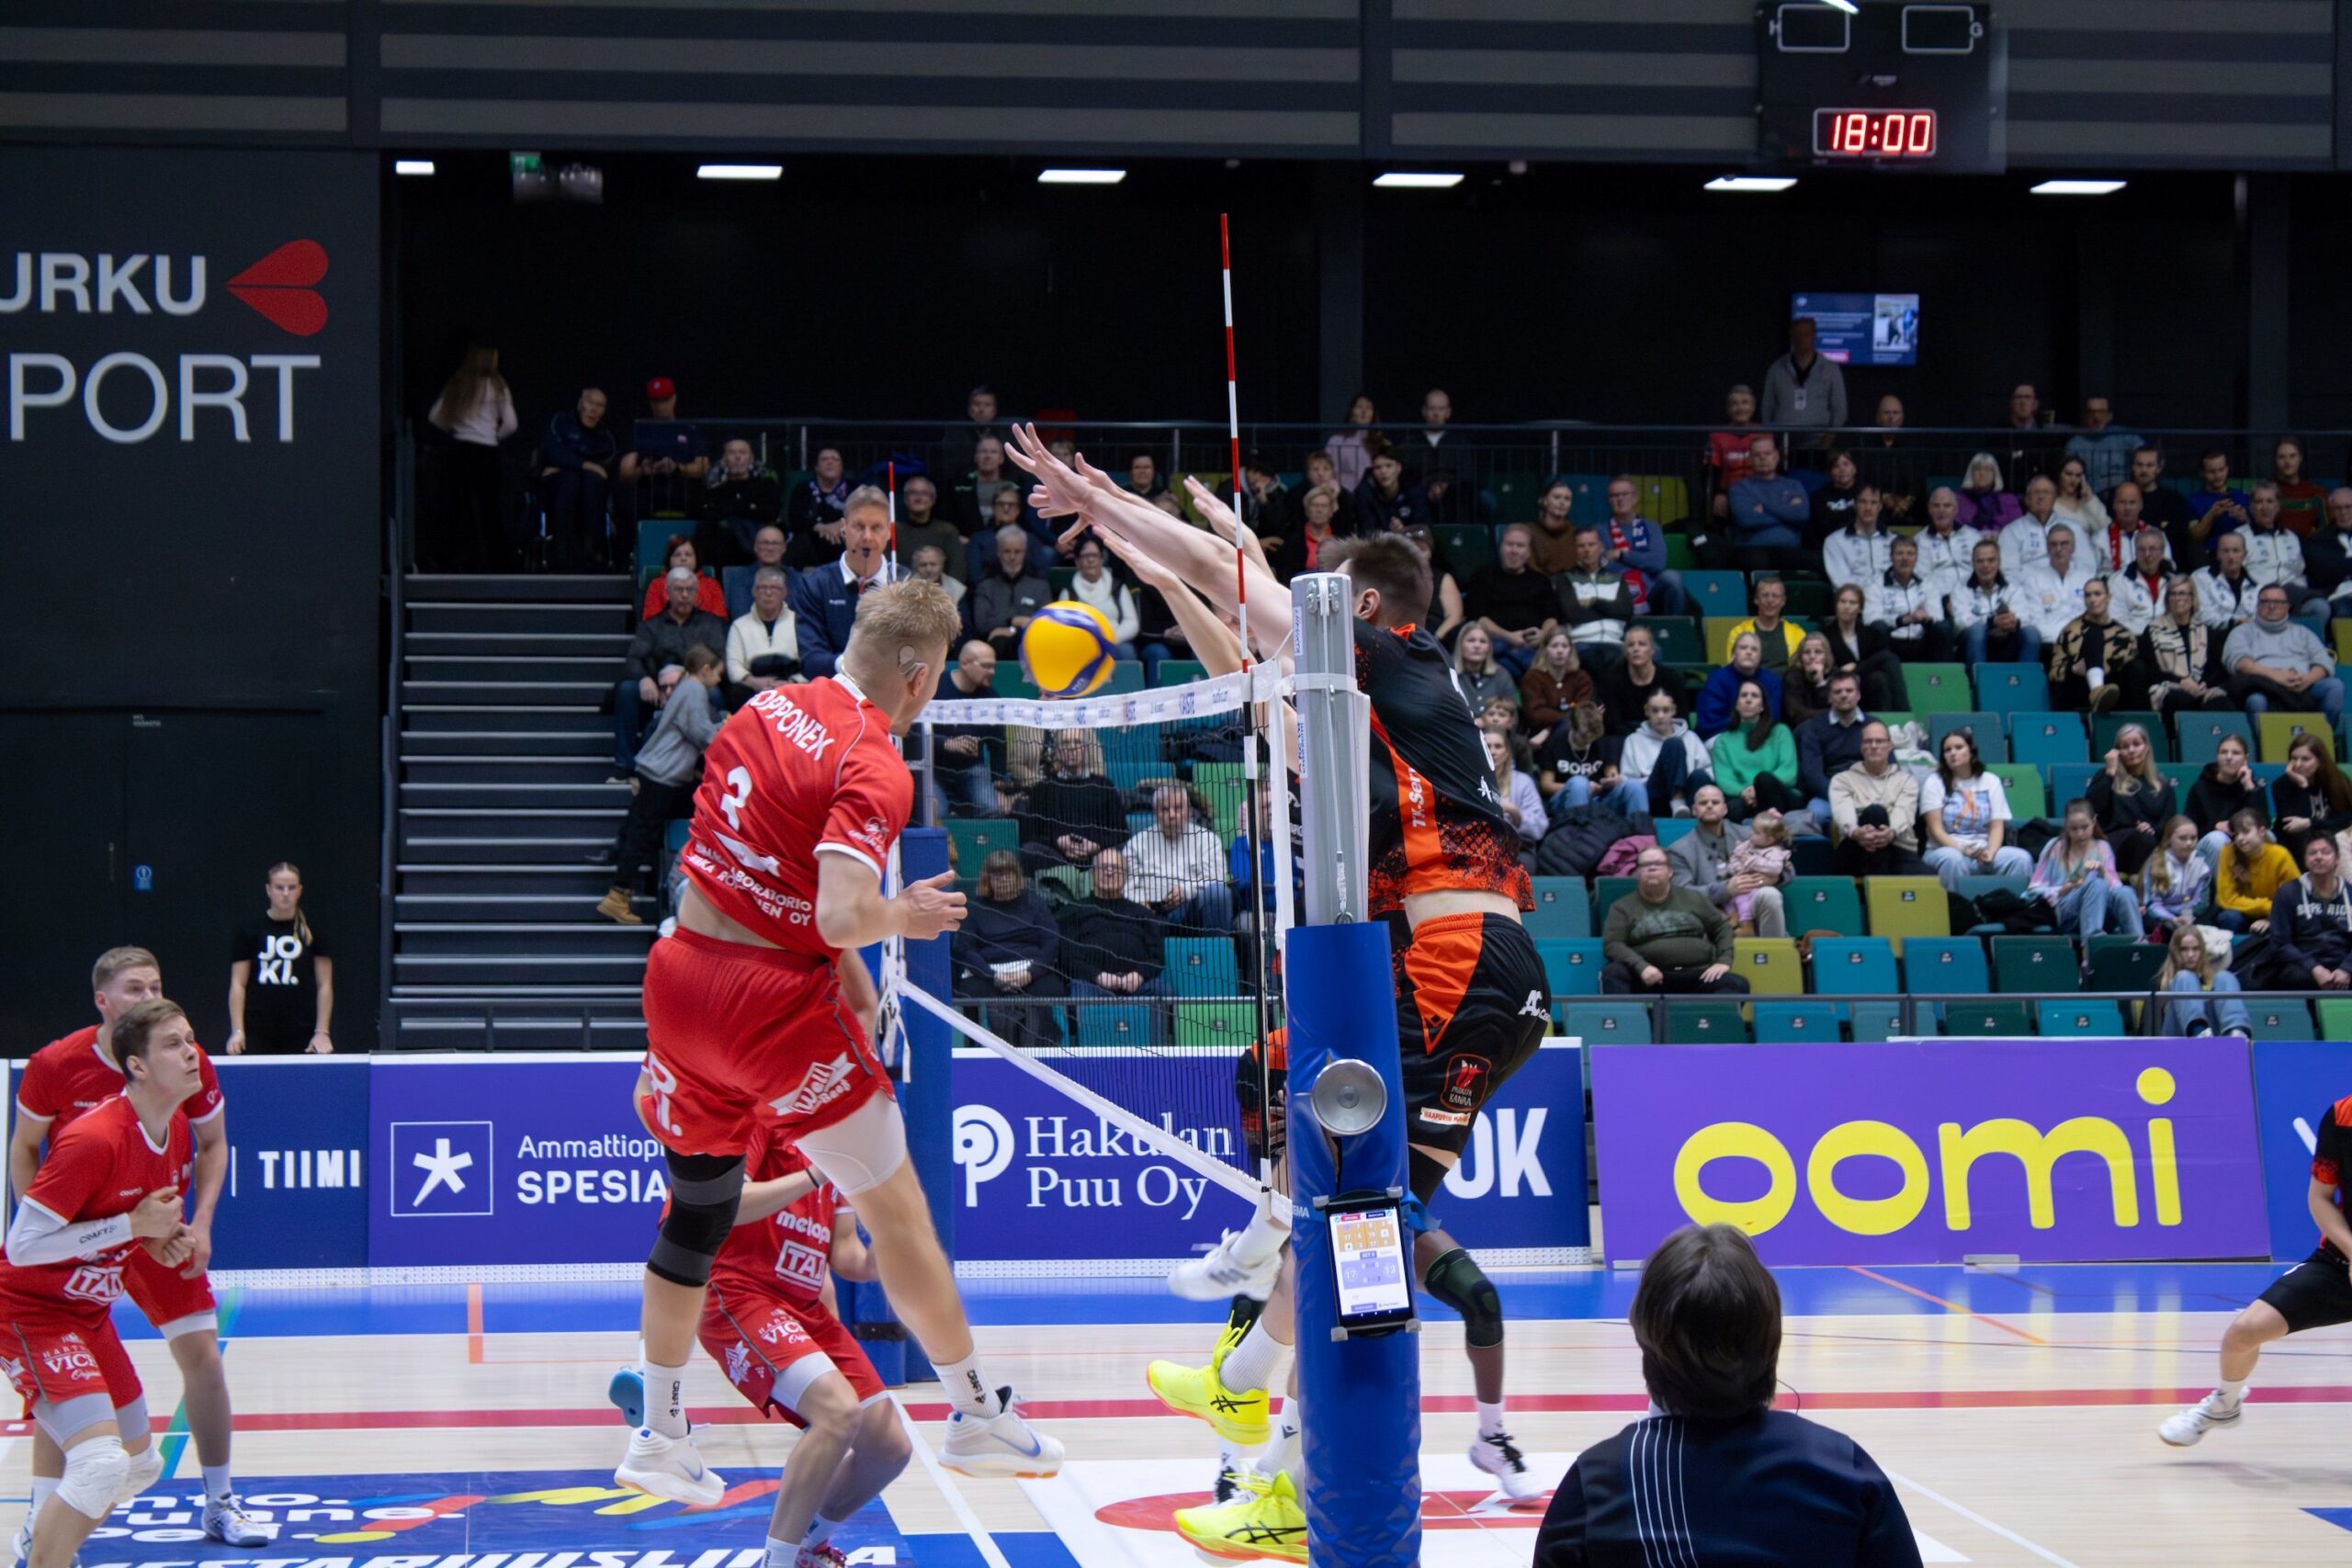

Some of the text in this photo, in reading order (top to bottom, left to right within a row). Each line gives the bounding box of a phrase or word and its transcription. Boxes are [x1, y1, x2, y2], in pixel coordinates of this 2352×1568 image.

[1833, 114, 1931, 152] 18:00
[0, 253, 206, 315] URKU
[10, 352, 321, 444] PORT
[258, 935, 303, 961] JO
[258, 959, 300, 986] KI.
[258, 1150, 360, 1189] TIIMI
[1673, 1066, 2183, 1237] oomi
[517, 1169, 667, 1204] SPESIA
[1026, 1166, 1208, 1221] Puu Oy
[1345, 1269, 1357, 1280] 17
[42, 1344, 89, 1358] HART
[117, 1493, 349, 1509] nto.
